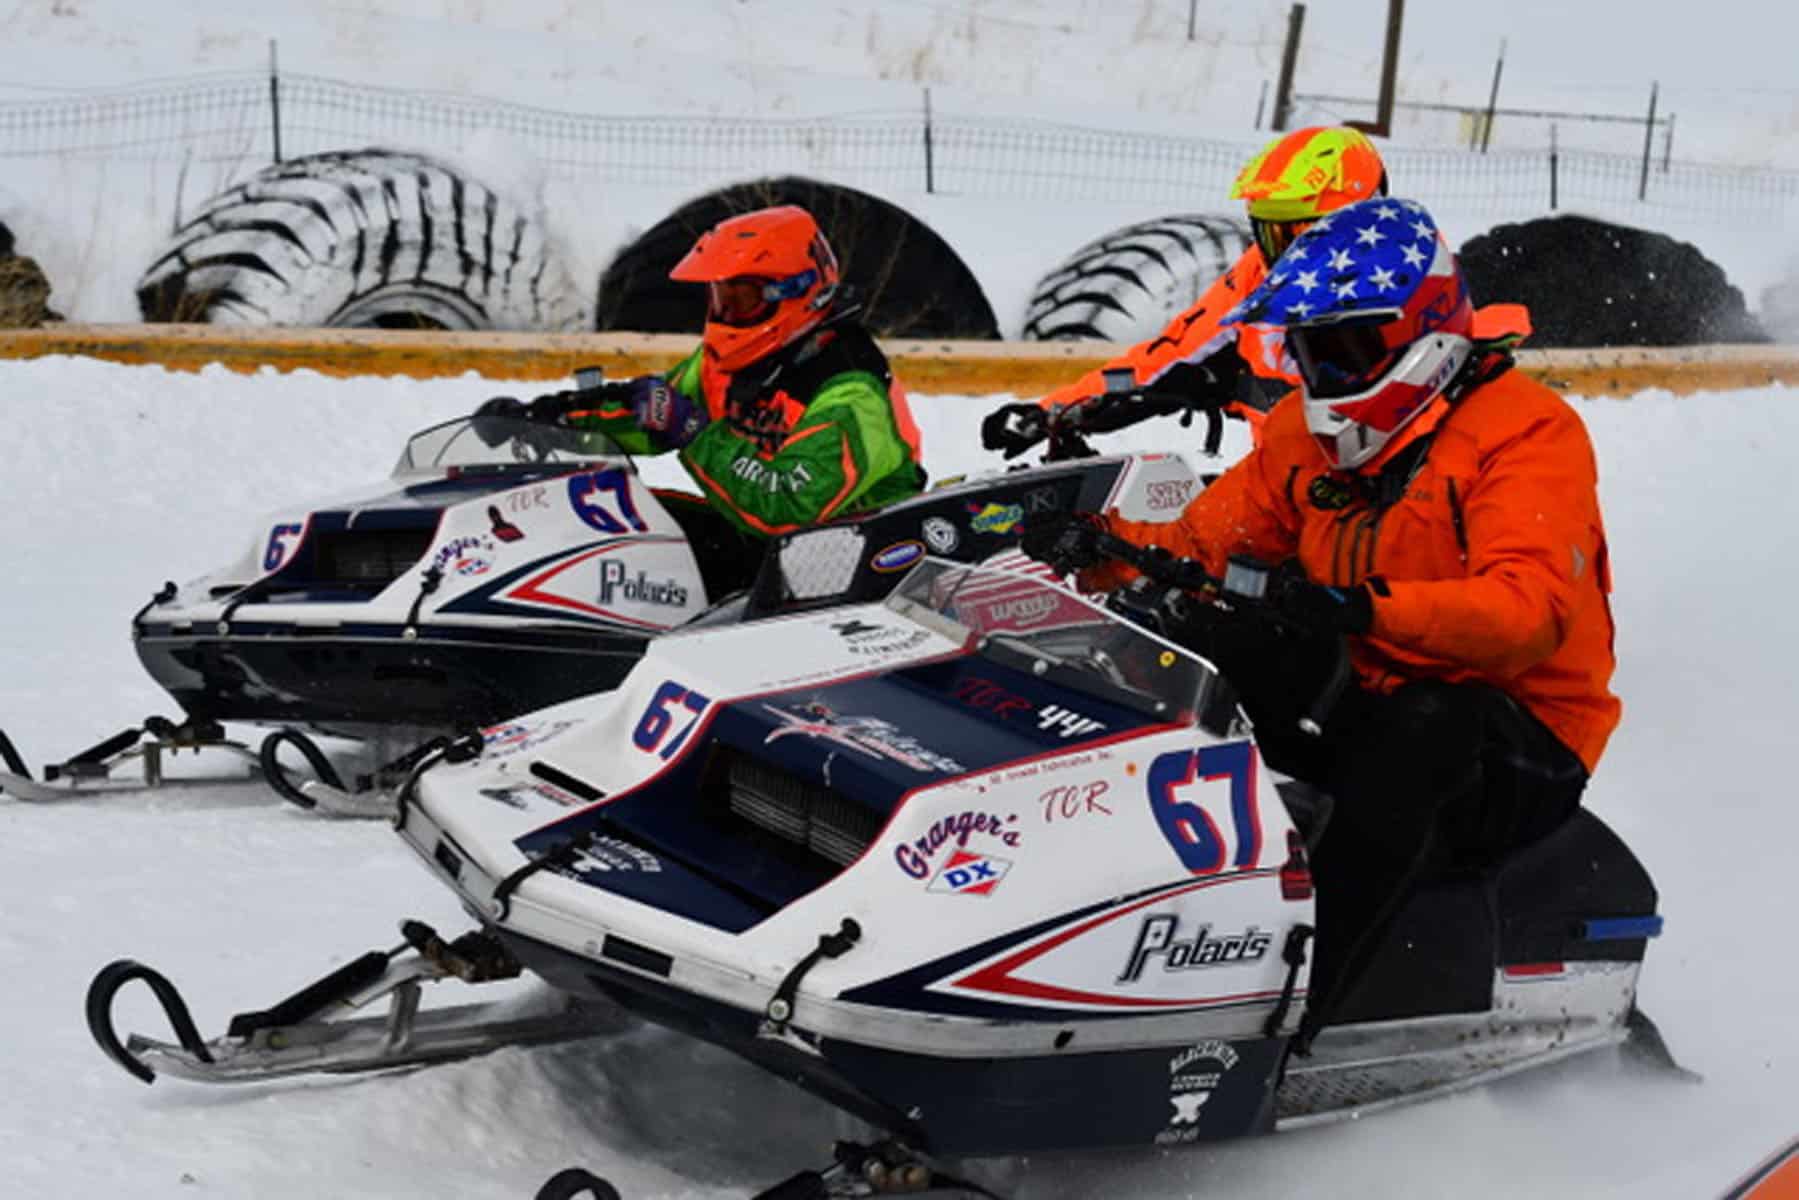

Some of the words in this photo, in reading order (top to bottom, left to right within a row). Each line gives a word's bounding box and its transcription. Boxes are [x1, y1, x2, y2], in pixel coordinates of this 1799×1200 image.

[568, 469, 649, 534] 67
[597, 558, 688, 608] Polaris
[631, 679, 712, 761] 67
[1038, 779, 1114, 823] TCR
[1147, 740, 1263, 876] 67
[944, 860, 998, 890] DX
[1114, 913, 1273, 986] Polaris
